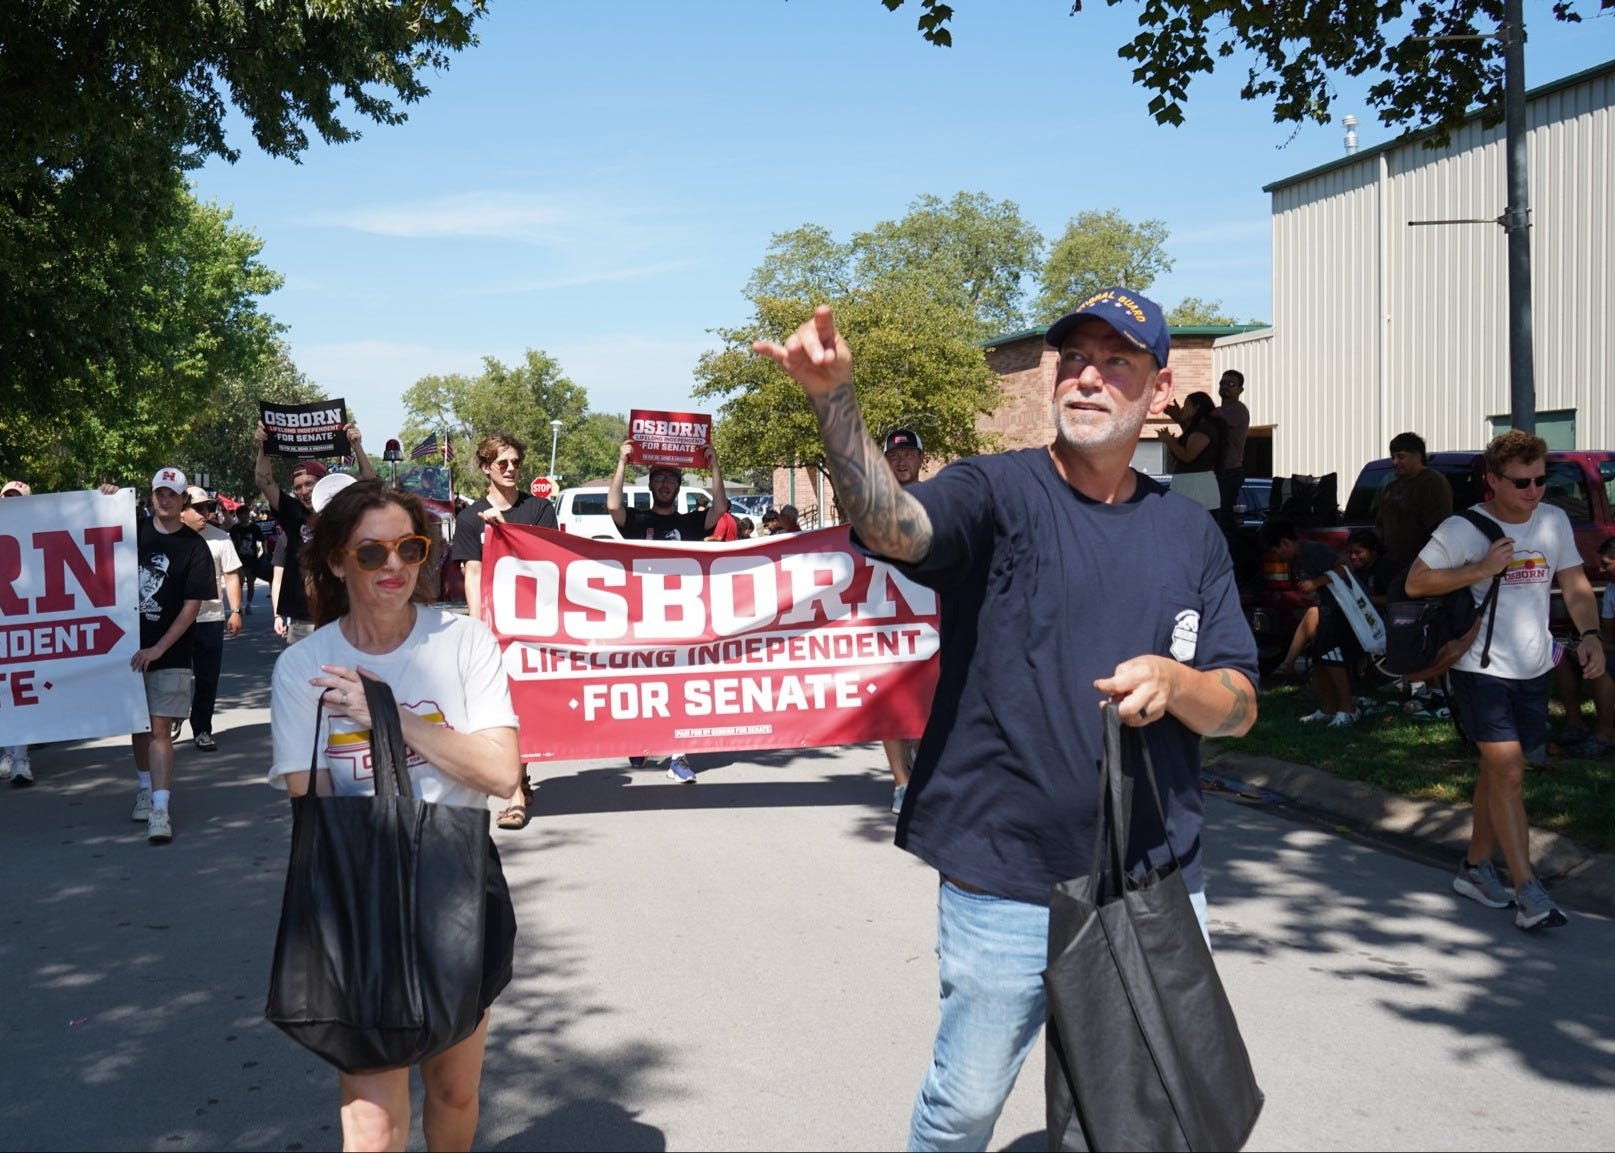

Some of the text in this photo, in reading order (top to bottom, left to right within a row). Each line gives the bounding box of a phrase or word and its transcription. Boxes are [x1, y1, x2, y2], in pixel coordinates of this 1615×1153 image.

[1118, 296, 1147, 322] GUARD
[264, 408, 342, 427] OSBORN
[269, 424, 339, 434] LIFELONG INDEPENDENT
[632, 419, 708, 438] OSBORN
[276, 432, 333, 442] FOR SENATE
[635, 434, 703, 445] LIFELONG INDEPENDENT
[642, 442, 696, 453] FOR SENATE
[533, 484, 552, 492] STOP
[1505, 569, 1545, 581] OSBORN
[493, 552, 937, 639] OSBORN
[520, 630, 921, 674] LIFELONG INDEPENDENT
[583, 672, 862, 721] FOR SENATE
